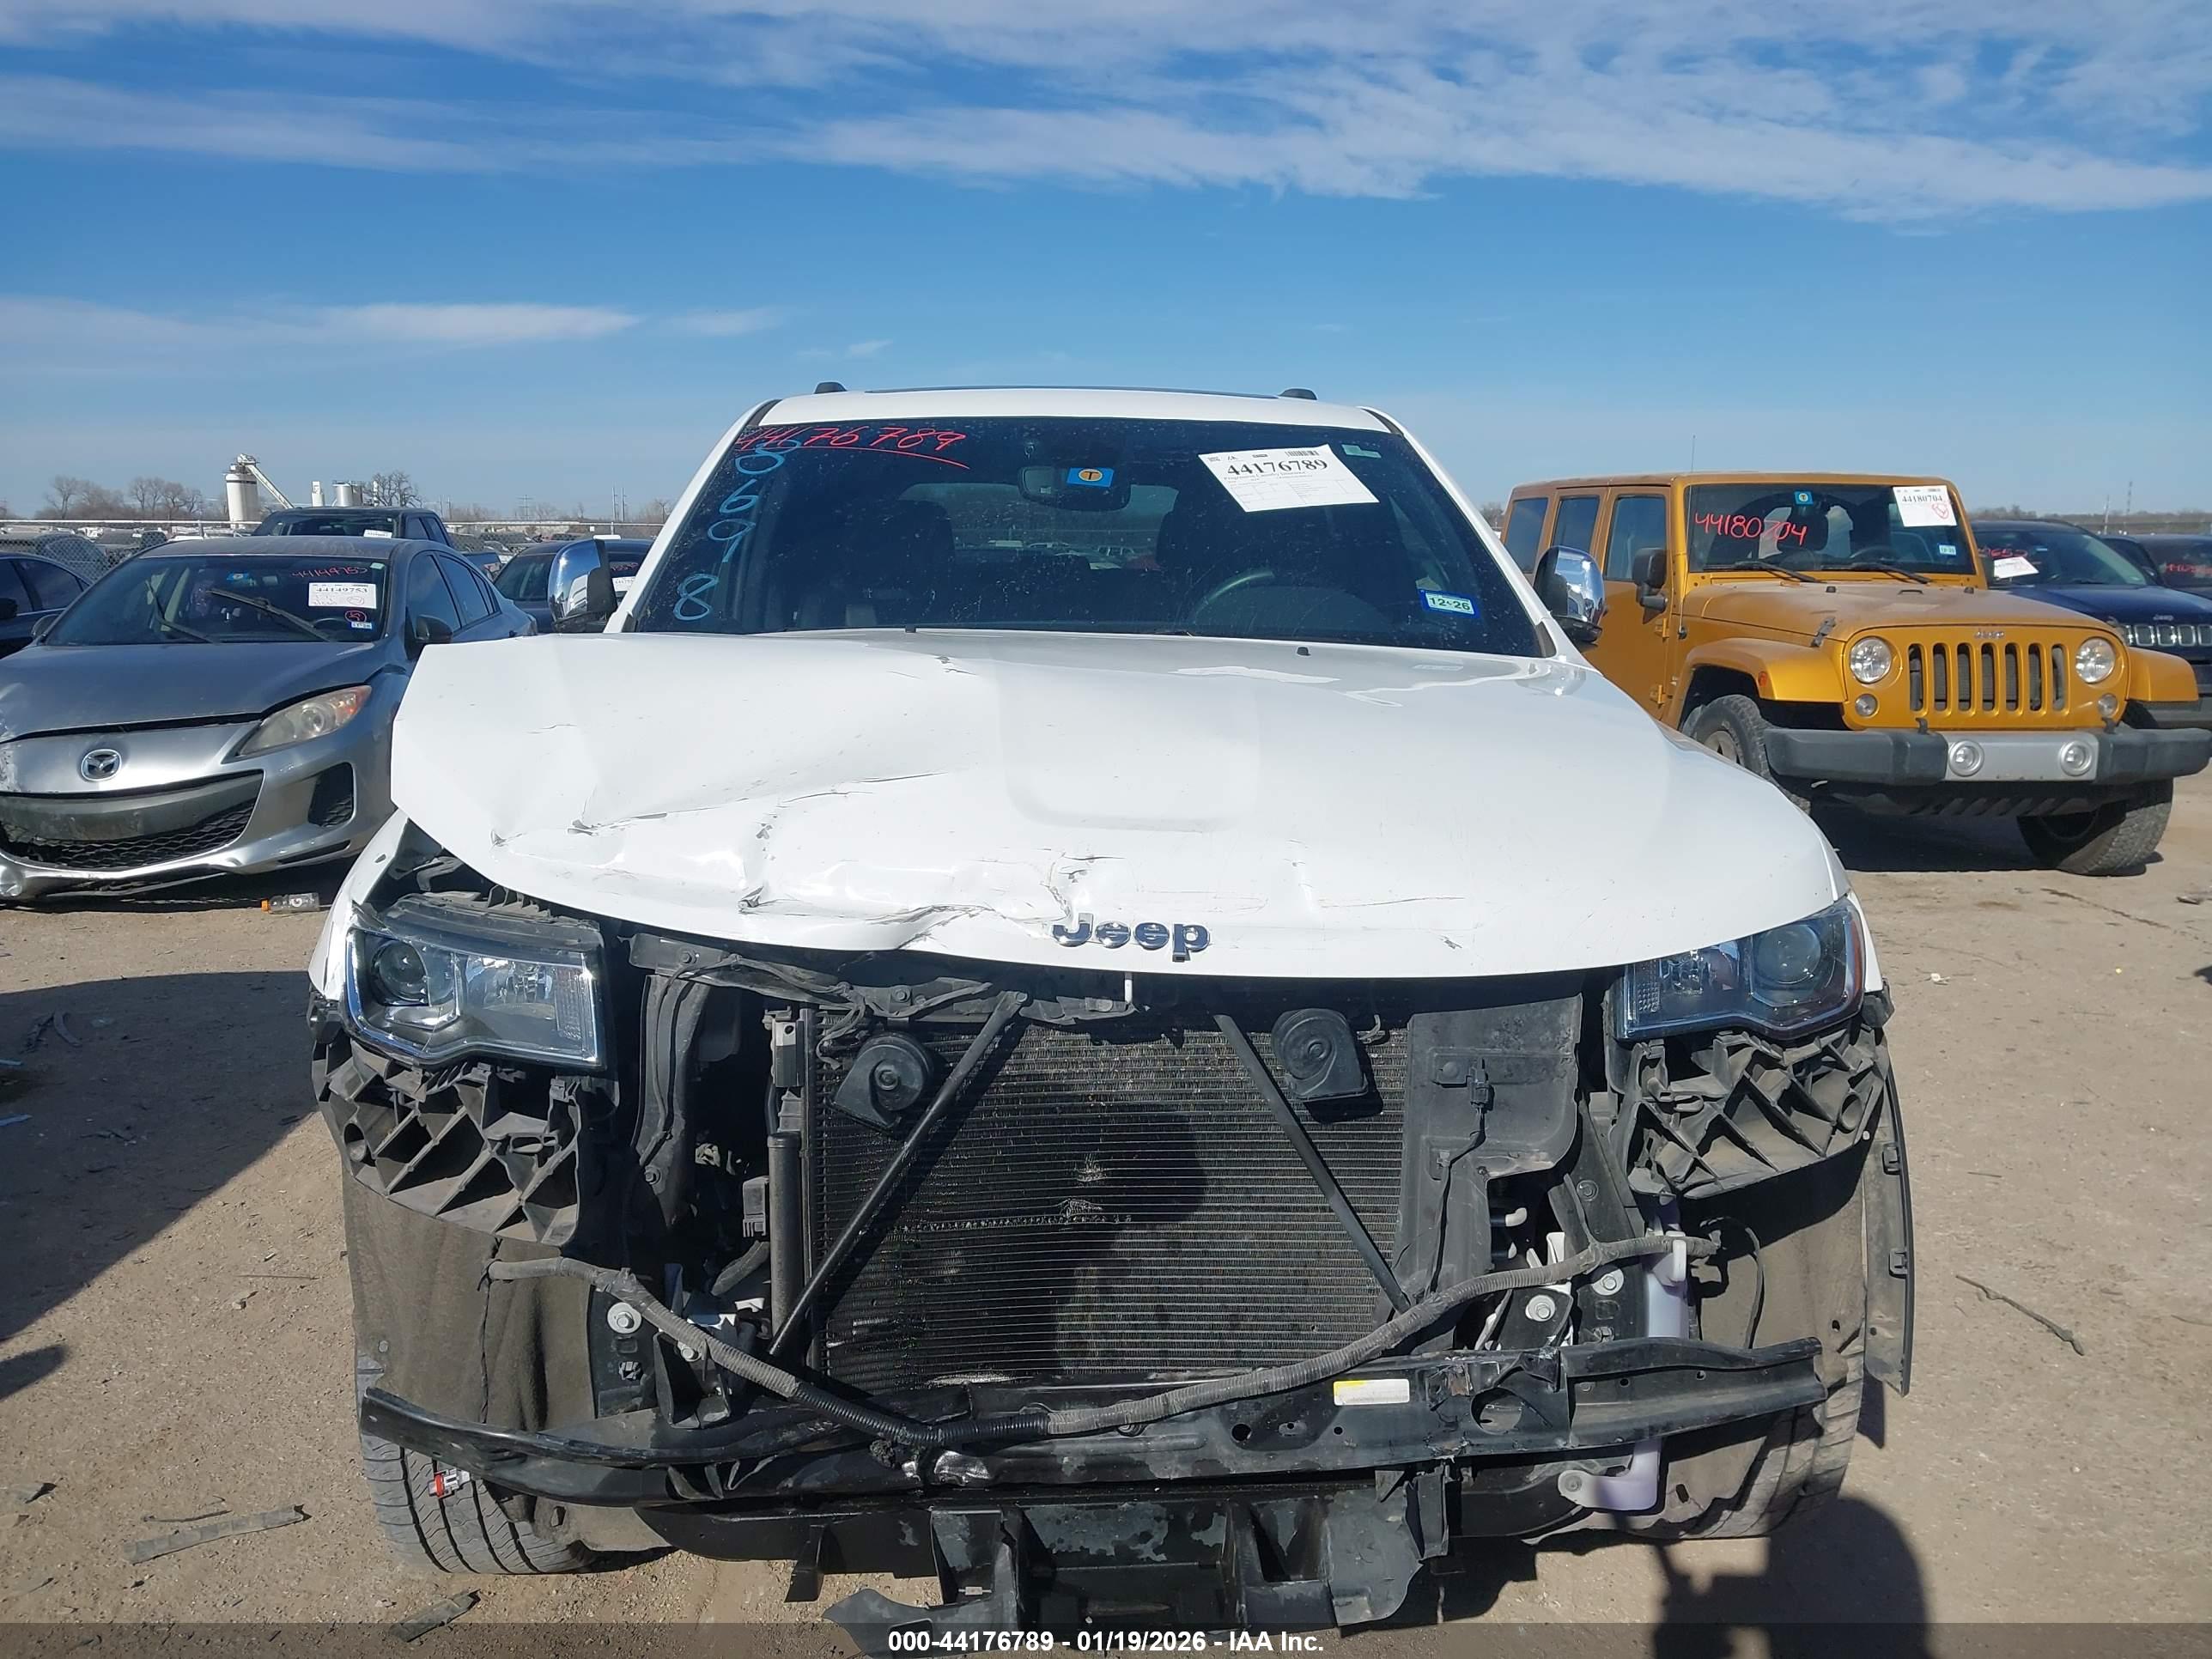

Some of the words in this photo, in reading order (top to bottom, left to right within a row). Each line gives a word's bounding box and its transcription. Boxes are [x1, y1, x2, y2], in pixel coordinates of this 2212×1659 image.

[1226, 458, 1328, 476] 44176789
[1902, 494, 1943, 503] 44180704
[1694, 513, 1808, 545] 44180704
[1052, 912, 1211, 963] Jeep
